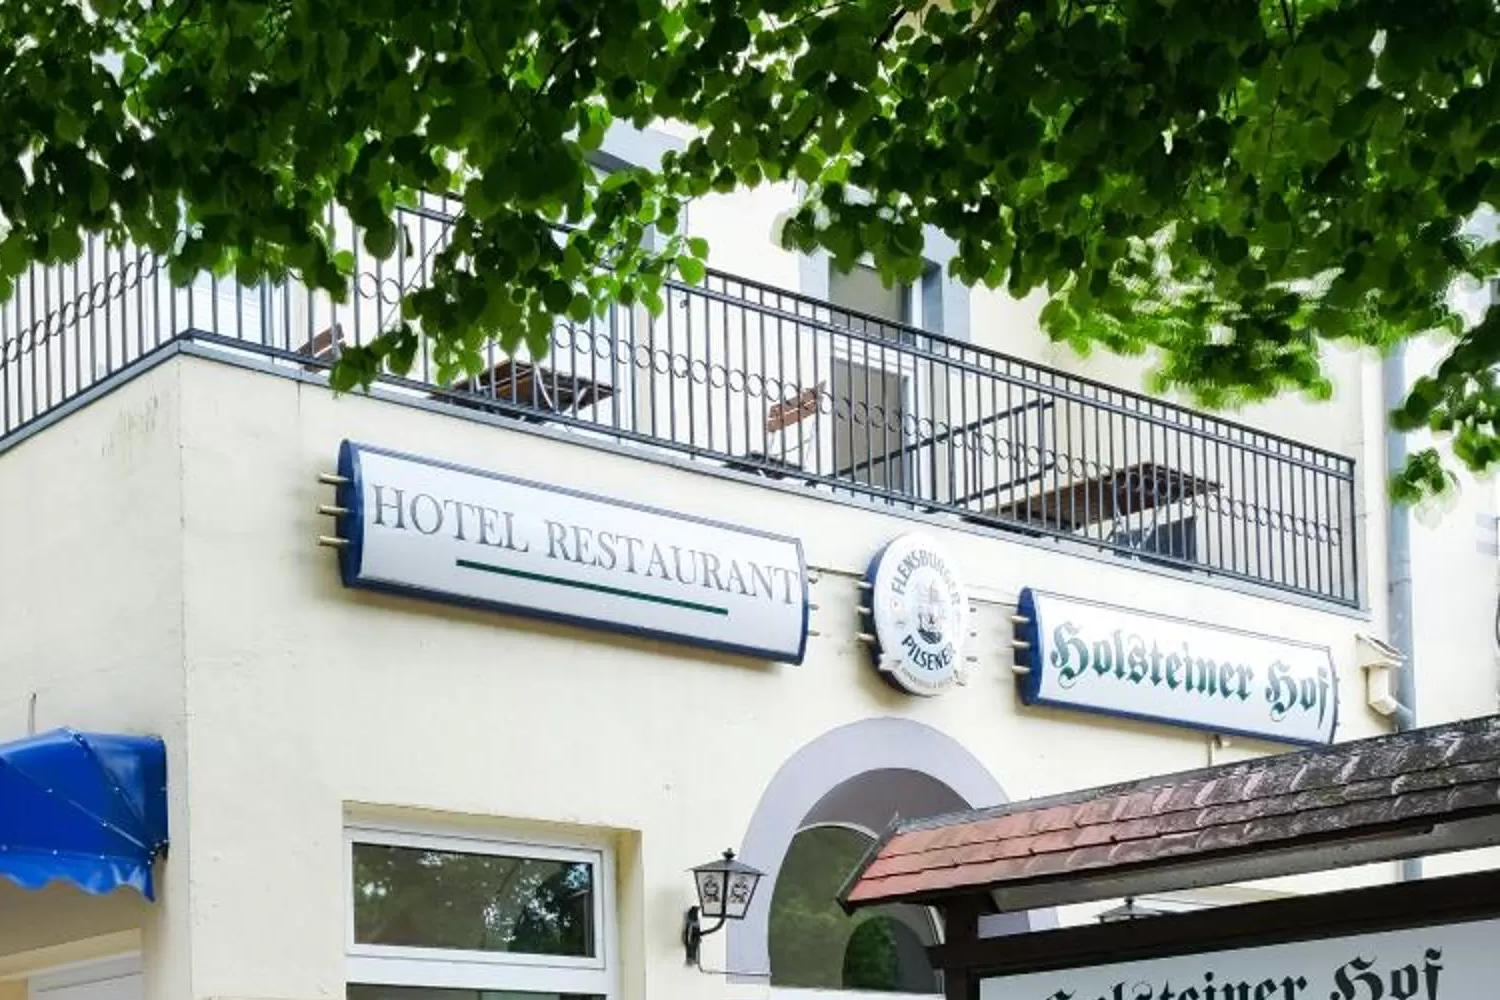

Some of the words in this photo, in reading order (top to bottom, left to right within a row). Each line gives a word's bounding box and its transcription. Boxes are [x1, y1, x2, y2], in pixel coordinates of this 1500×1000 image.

[371, 484, 529, 554] HOTEL
[545, 519, 799, 605] RESTAURANT
[1050, 620, 1253, 701] Holsteiner
[1265, 662, 1331, 730] Hof
